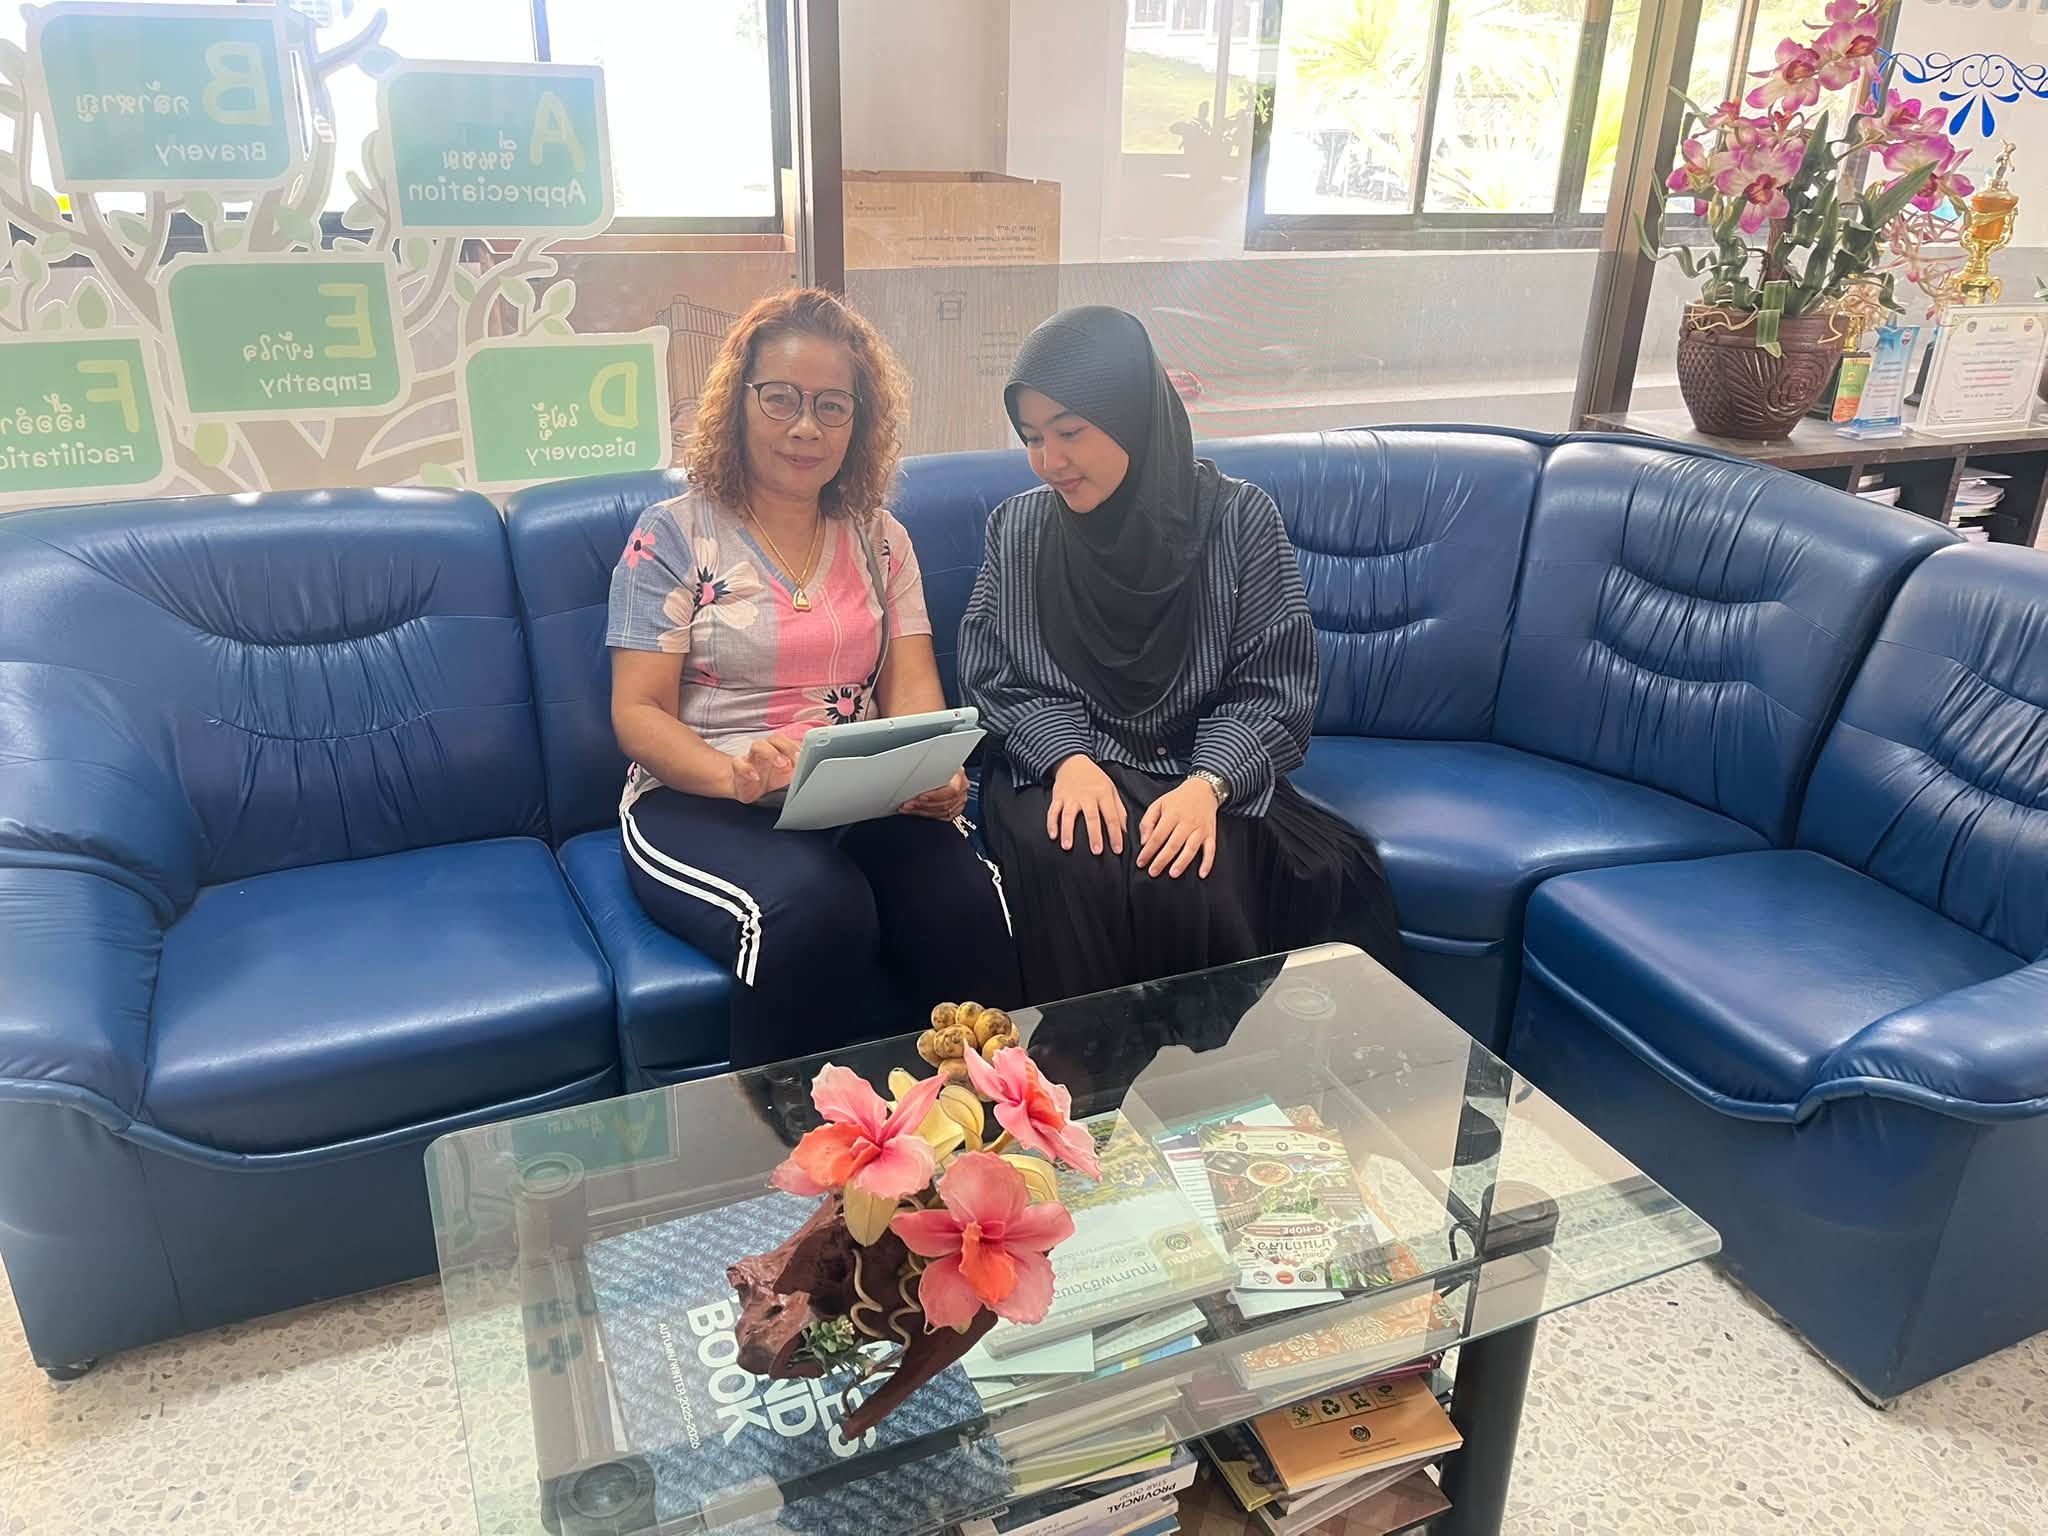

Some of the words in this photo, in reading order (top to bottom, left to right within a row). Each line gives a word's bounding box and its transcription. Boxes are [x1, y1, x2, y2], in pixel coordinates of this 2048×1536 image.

[1281, 1224, 1322, 1235] D-HOPE
[687, 1299, 771, 1446] BOOK
[679, 1397, 700, 1450] 2025-2026
[1106, 1482, 1177, 1513] PROVINCIAL
